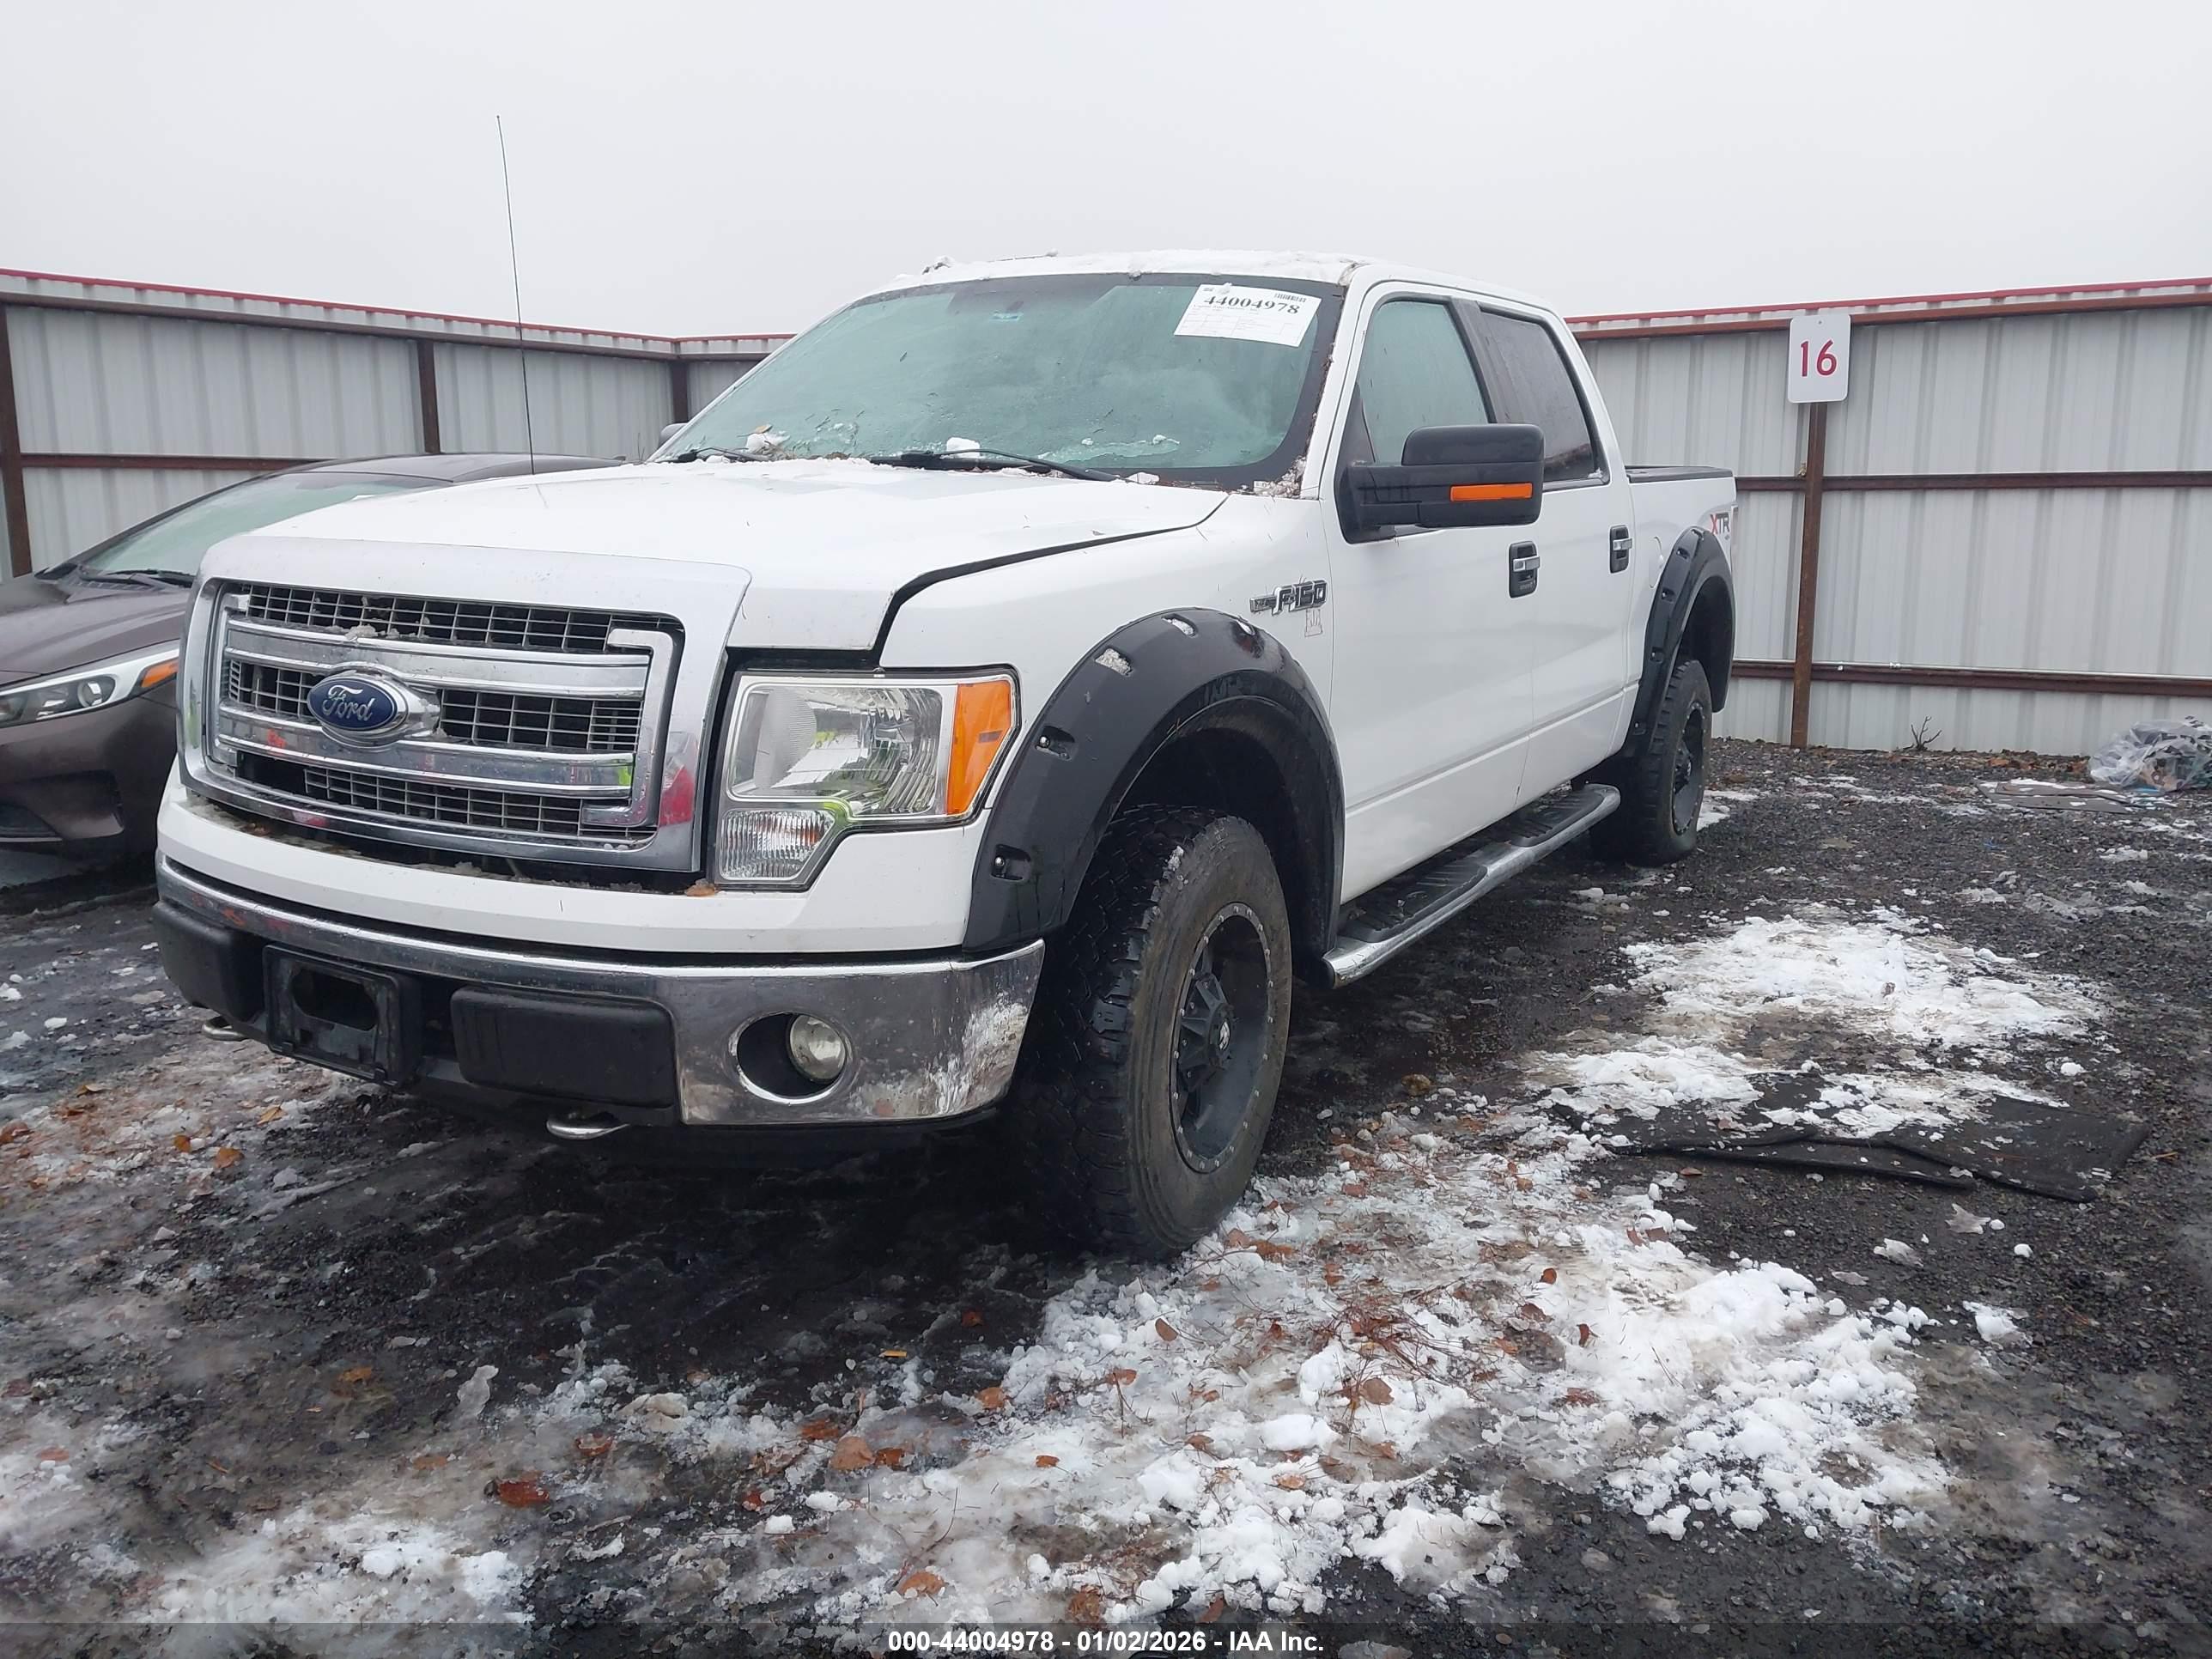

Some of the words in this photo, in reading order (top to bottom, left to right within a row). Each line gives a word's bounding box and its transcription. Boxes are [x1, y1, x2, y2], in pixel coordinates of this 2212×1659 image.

[1204, 295, 1301, 314] 44004978
[1801, 339, 1838, 377] 16
[1710, 512, 1730, 534] XTR
[322, 684, 376, 721] Ford
